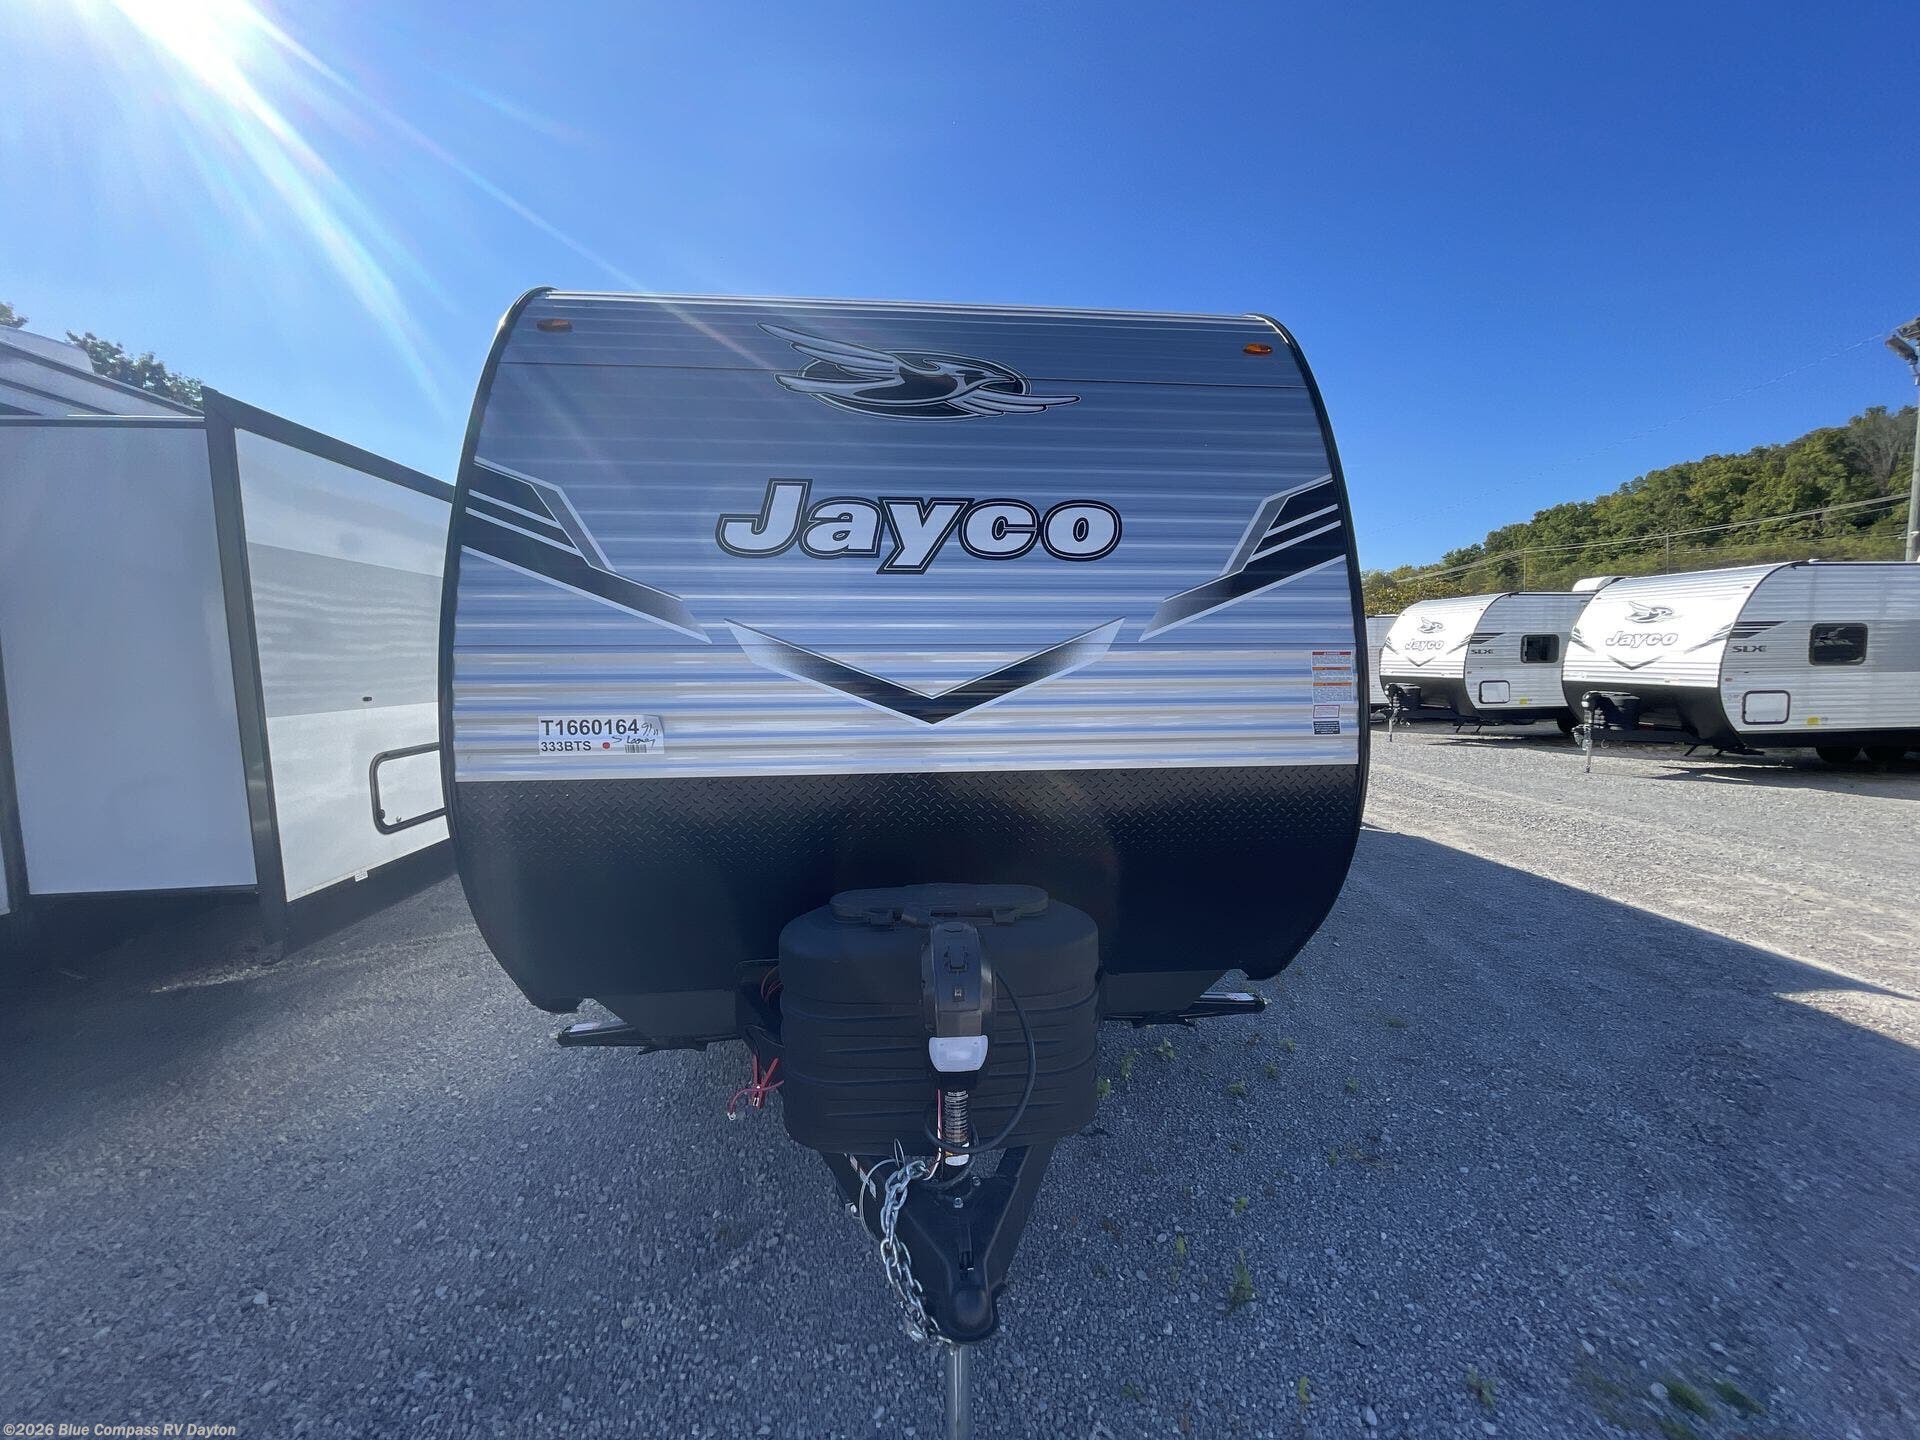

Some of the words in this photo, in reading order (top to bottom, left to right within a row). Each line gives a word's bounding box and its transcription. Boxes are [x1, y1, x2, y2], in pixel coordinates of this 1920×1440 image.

[715, 478, 1122, 575] Jayco
[1405, 638, 1445, 651] Jayco
[1605, 631, 1679, 648] Jayco
[1732, 645, 1767, 653] SLX
[541, 718, 639, 736] T1660164
[541, 740, 592, 752] 333BTS
